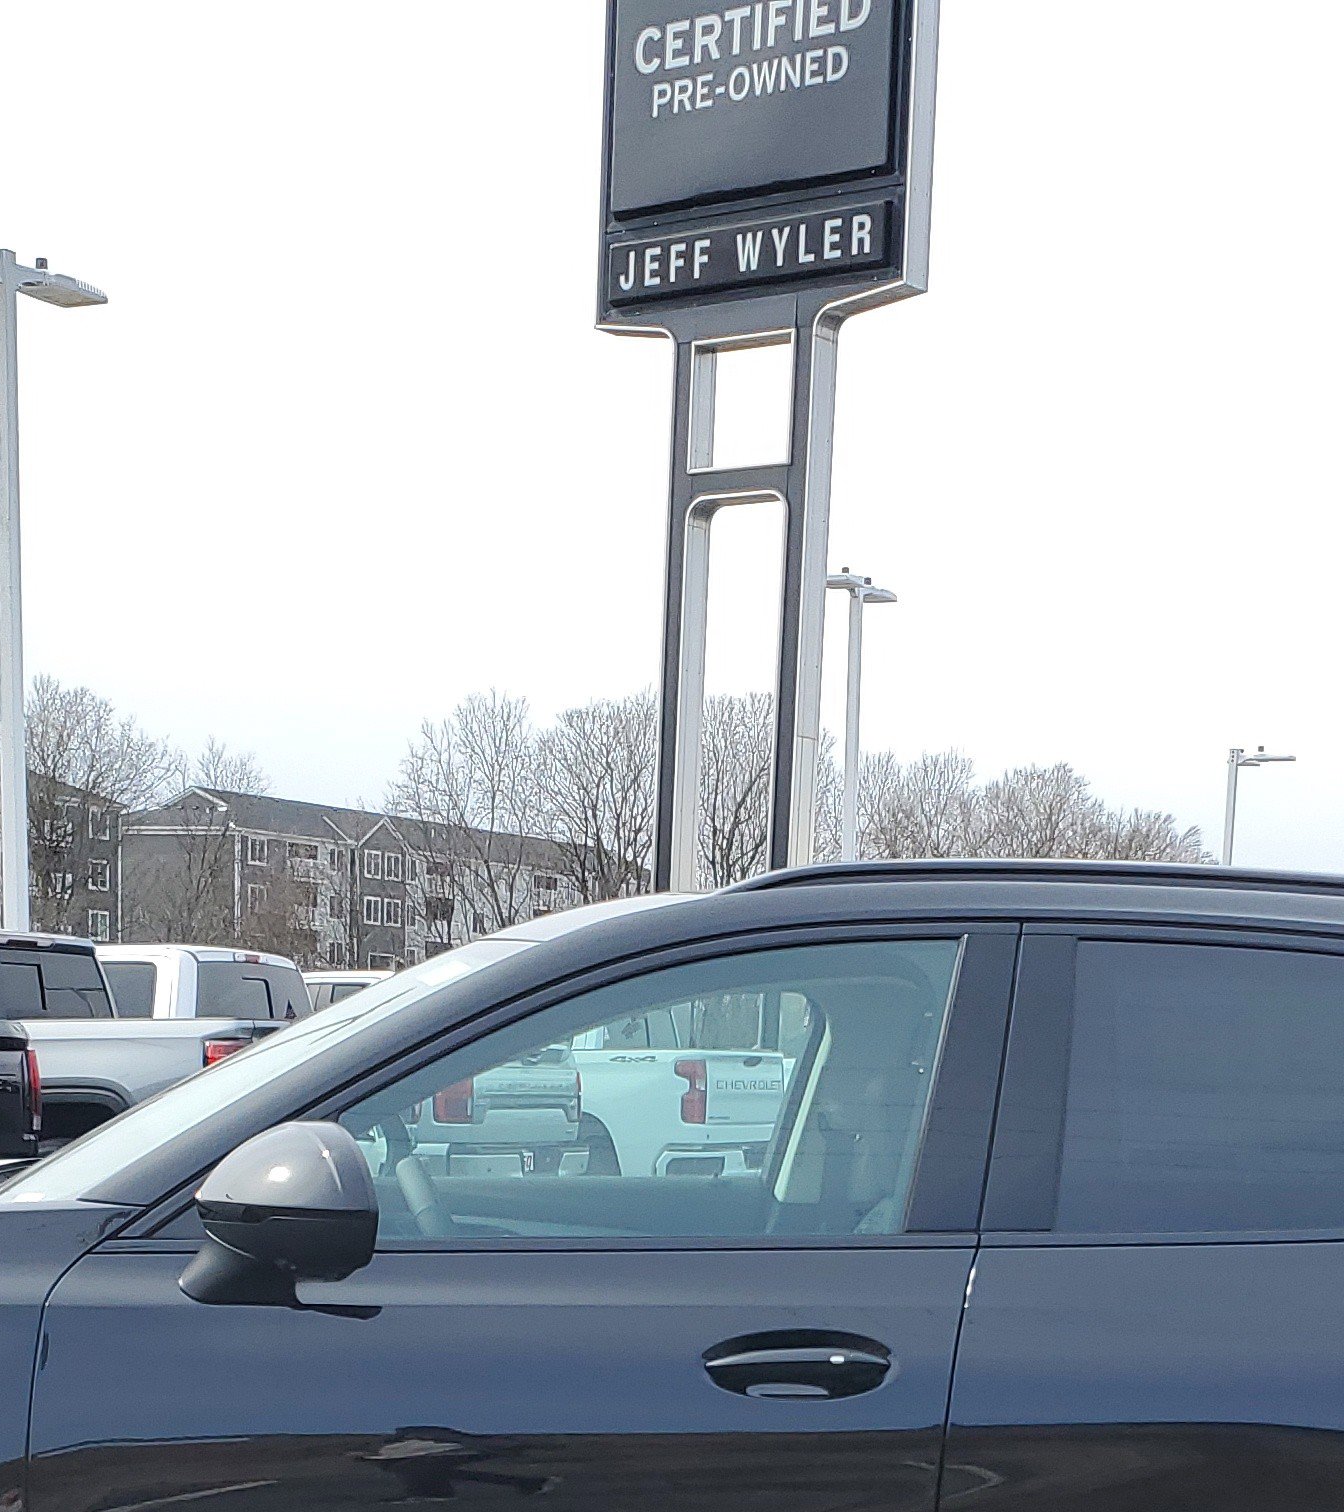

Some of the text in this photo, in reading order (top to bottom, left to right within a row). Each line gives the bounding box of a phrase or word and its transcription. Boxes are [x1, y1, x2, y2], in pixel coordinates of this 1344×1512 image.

[634, 0, 871, 75] CERTIFIED
[650, 45, 850, 119] PRE-OWNED
[619, 213, 873, 292] JEFF WYLER
[716, 1080, 781, 1091] CHEVROLET
